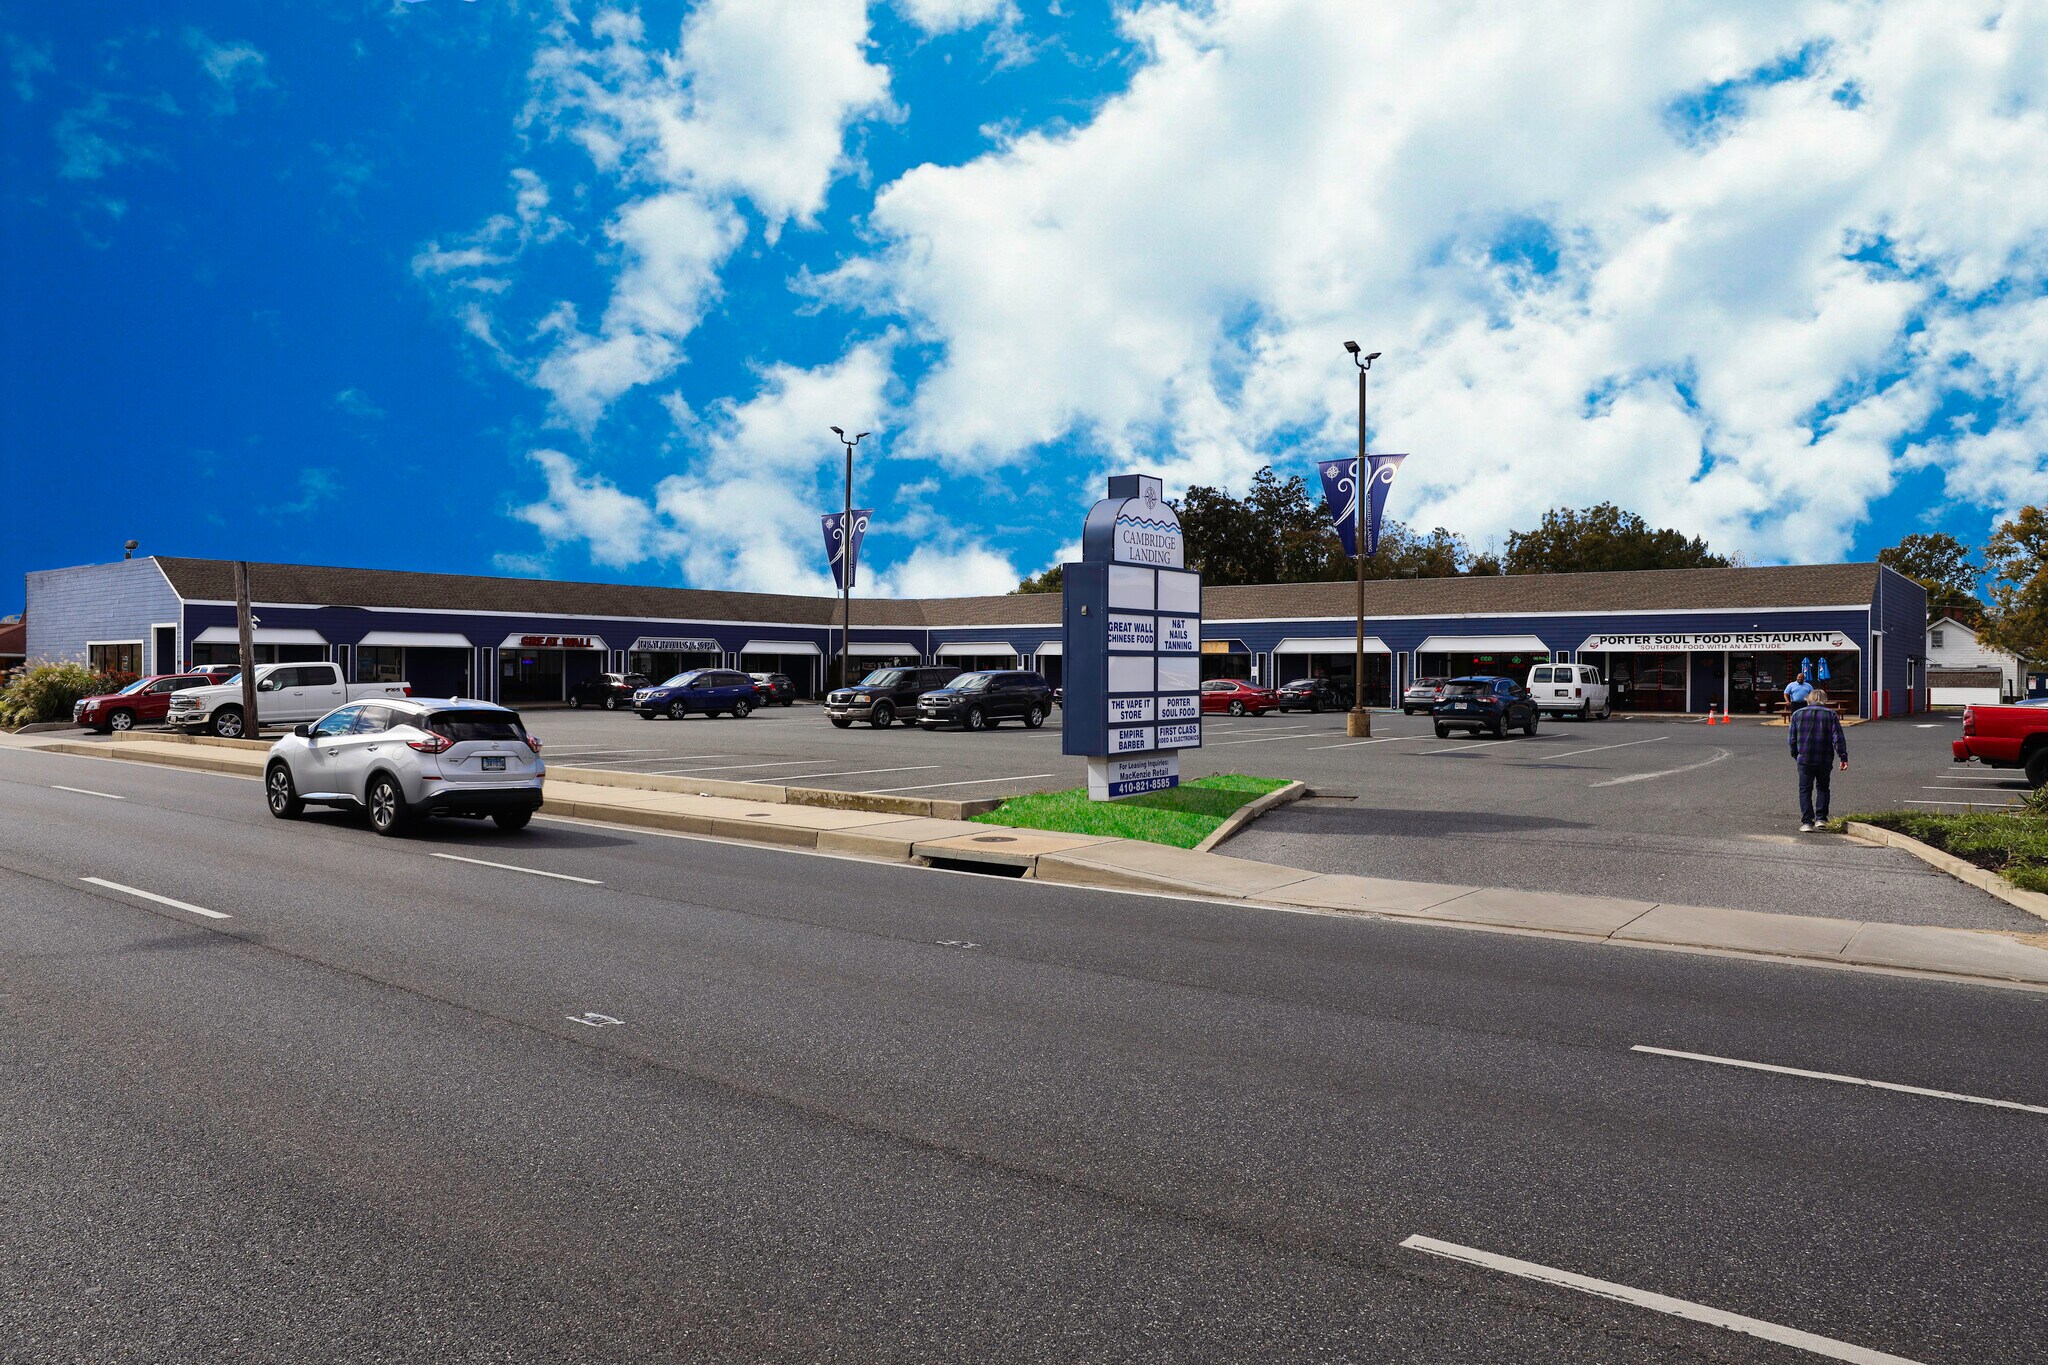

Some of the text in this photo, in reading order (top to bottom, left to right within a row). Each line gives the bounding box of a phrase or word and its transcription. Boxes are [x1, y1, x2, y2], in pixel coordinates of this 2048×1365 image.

[1123, 530, 1176, 550] CAMBRIDGE
[1129, 547, 1171, 565] LANDING
[1108, 621, 1153, 633] GREAT WALL
[1172, 619, 1185, 628] N&T
[1108, 633, 1154, 644] CHINESE FOOD
[1169, 630, 1188, 640] NAILS
[1599, 633, 1833, 645] PORTER SOUL FOOD RESTAURANT
[520, 635, 594, 648] GREAT WALL
[698, 640, 716, 650] SPA
[1164, 640, 1192, 650] TANNING
[1111, 699, 1151, 709] THE VAPE IT
[1167, 698, 1191, 707] PORTER
[1120, 710, 1142, 720] STORE
[1161, 707, 1196, 718] SOUL FOOD
[1119, 729, 1144, 739] EMPIRE
[1159, 725, 1197, 737] FIRST CLASS
[1174, 734, 1199, 742] ELECTRONICS
[1118, 740, 1145, 750] BARBER
[1128, 761, 1147, 770] Leasing
[1147, 760, 1169, 768] Inquiries:
[1119, 767, 1169, 781] MacKenzie Retail
[1118, 778, 1170, 794] 410-821-8585
